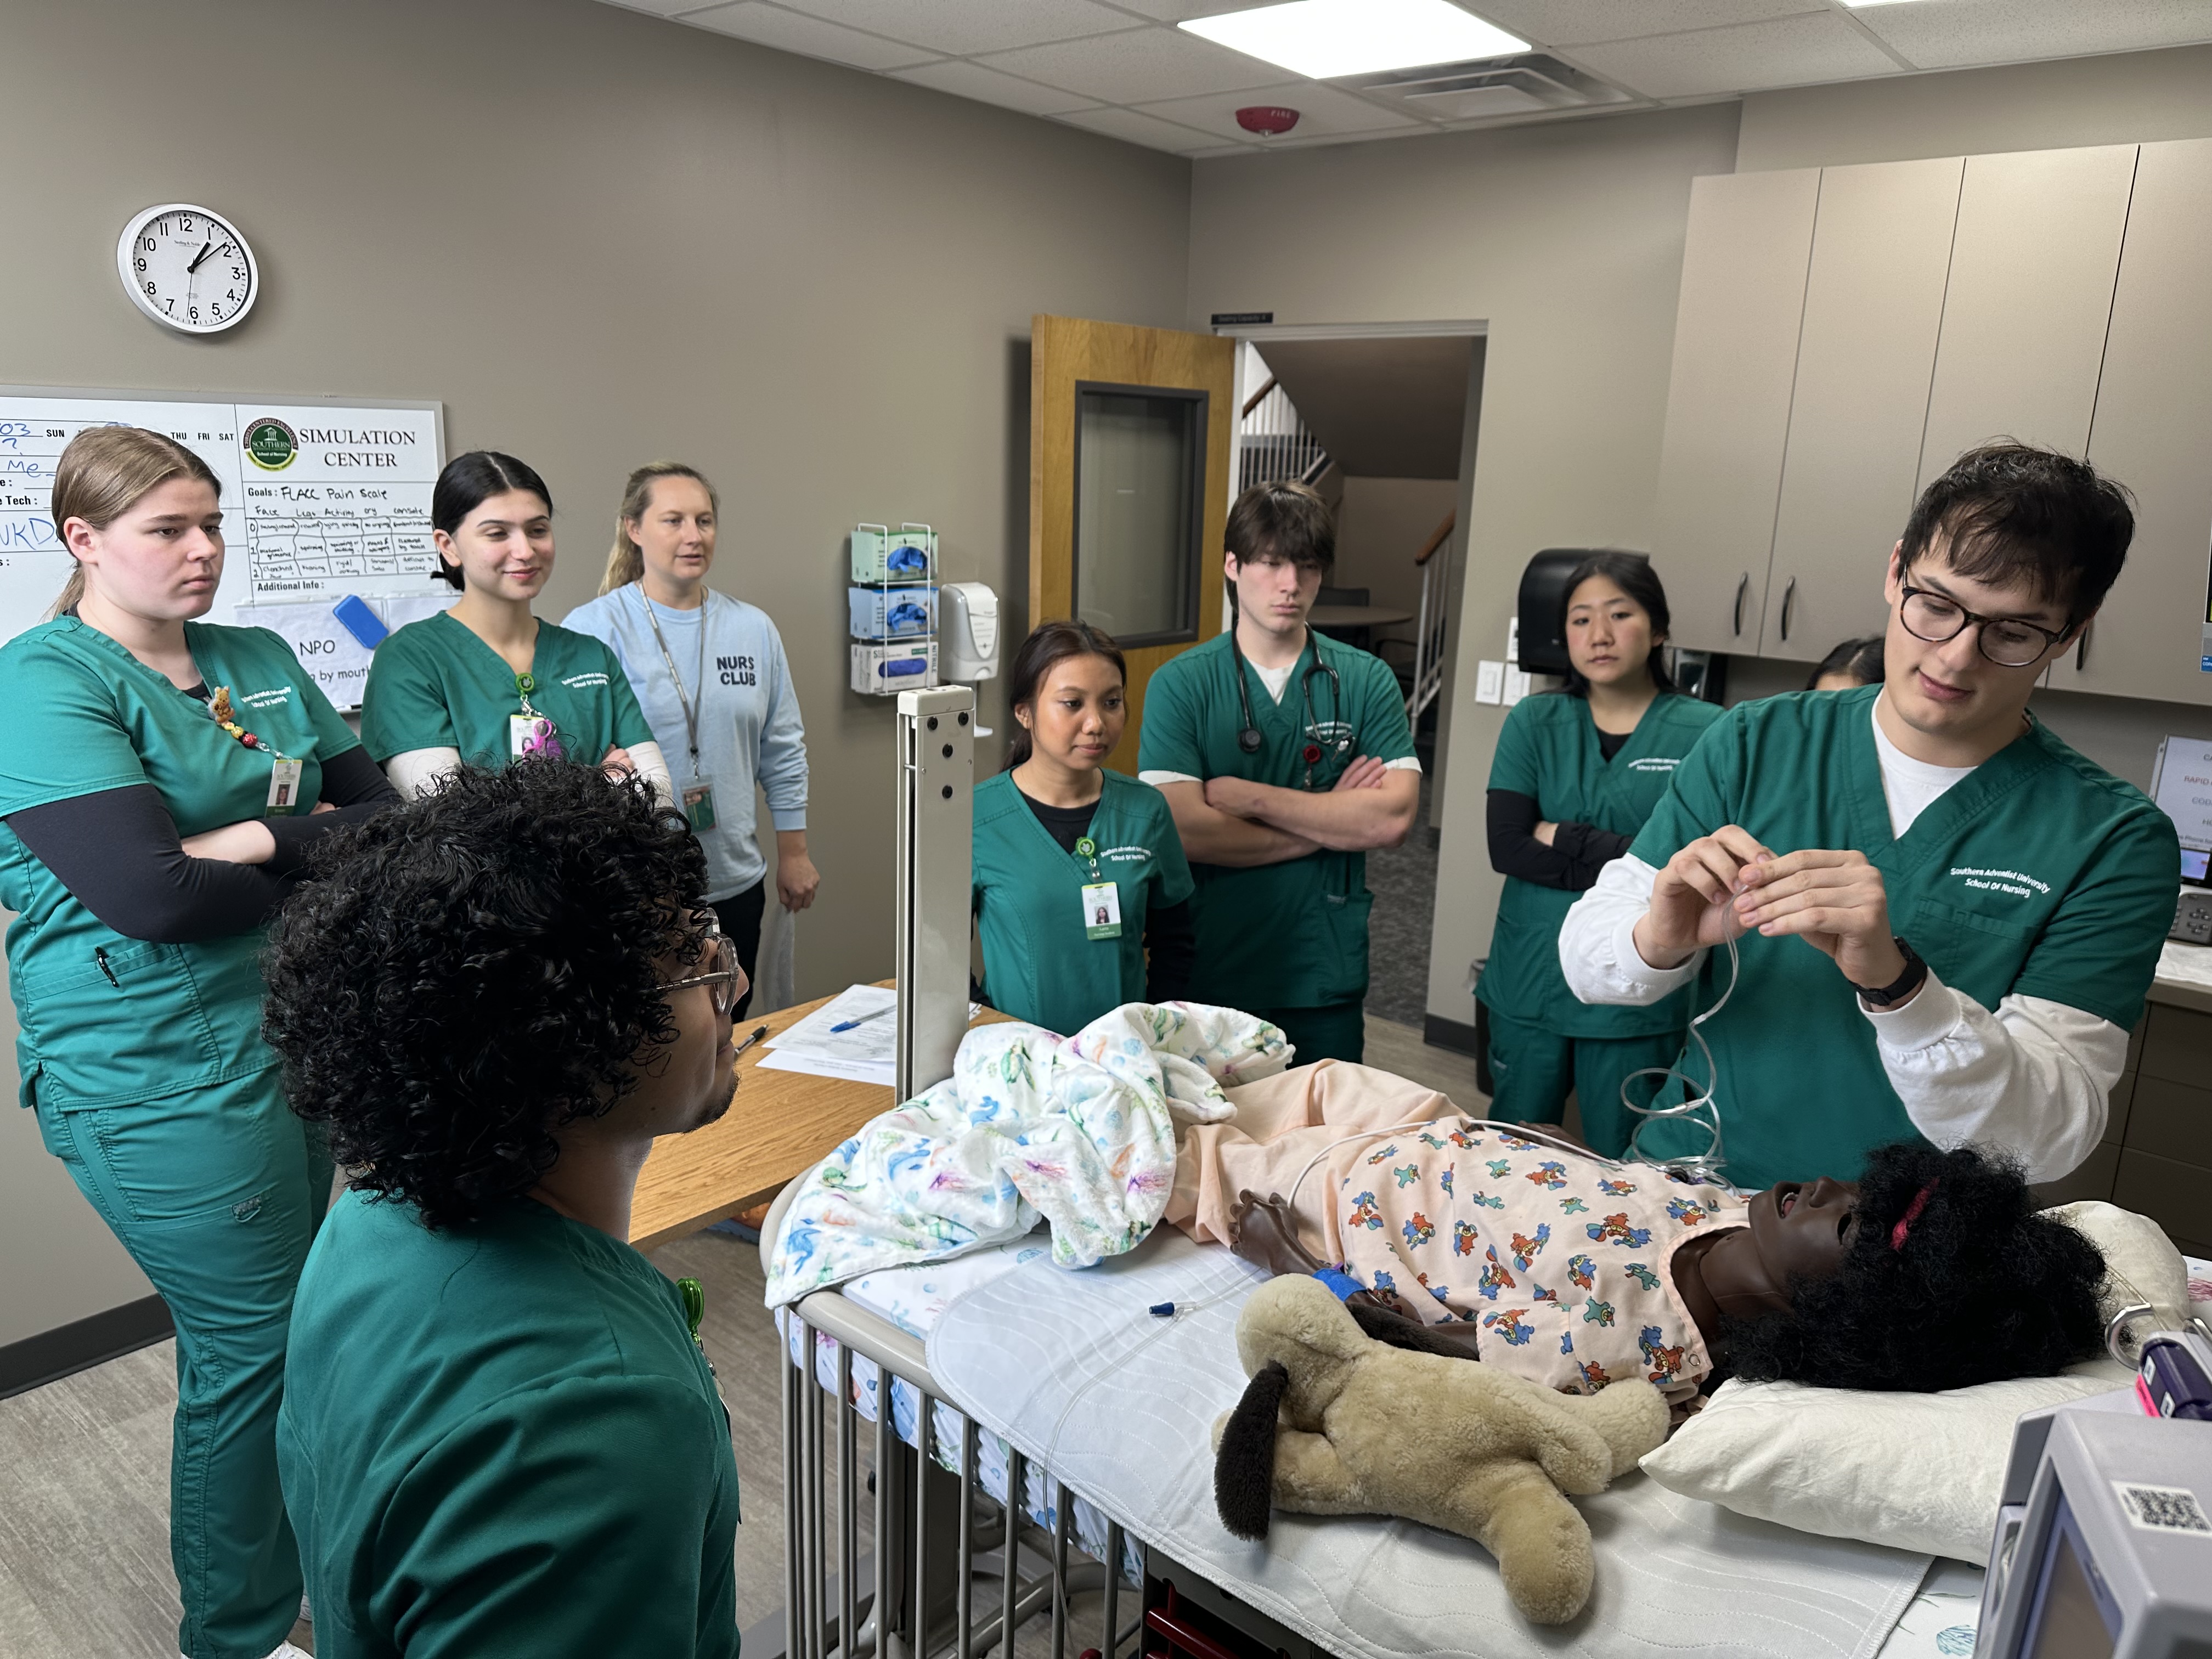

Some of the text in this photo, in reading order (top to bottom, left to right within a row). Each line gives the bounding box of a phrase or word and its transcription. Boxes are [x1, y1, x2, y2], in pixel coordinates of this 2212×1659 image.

[160, 222, 168, 236] 11
[179, 218, 193, 232] 12
[207, 227, 211, 240] 1
[143, 237, 156, 251] 10
[223, 244, 232, 257] 2
[137, 258, 146, 271] 9
[232, 267, 240, 280] 3
[147, 281, 156, 295] 8
[227, 289, 235, 301] 4
[166, 298, 174, 311] 7
[212, 303, 220, 315] 5
[189, 307, 199, 319] 6
[46, 429, 65, 437] SUN
[171, 432, 234, 441] THU FRI SAT
[300, 428, 416, 445] SIMULATION
[324, 452, 398, 467] CENTER
[281, 486, 387, 501] FLACC Pain Scale
[255, 505, 280, 516] Face
[258, 581, 300, 591] Additional
[300, 640, 336, 656] NPO
[716, 656, 754, 670] NURS
[320, 670, 334, 682] by
[720, 671, 756, 686] CLUB
[2184, 775, 2209, 786] RAPID
[1950, 866, 2051, 895] Southern Adventist University
[1964, 877, 2032, 899] School Of Nursing
